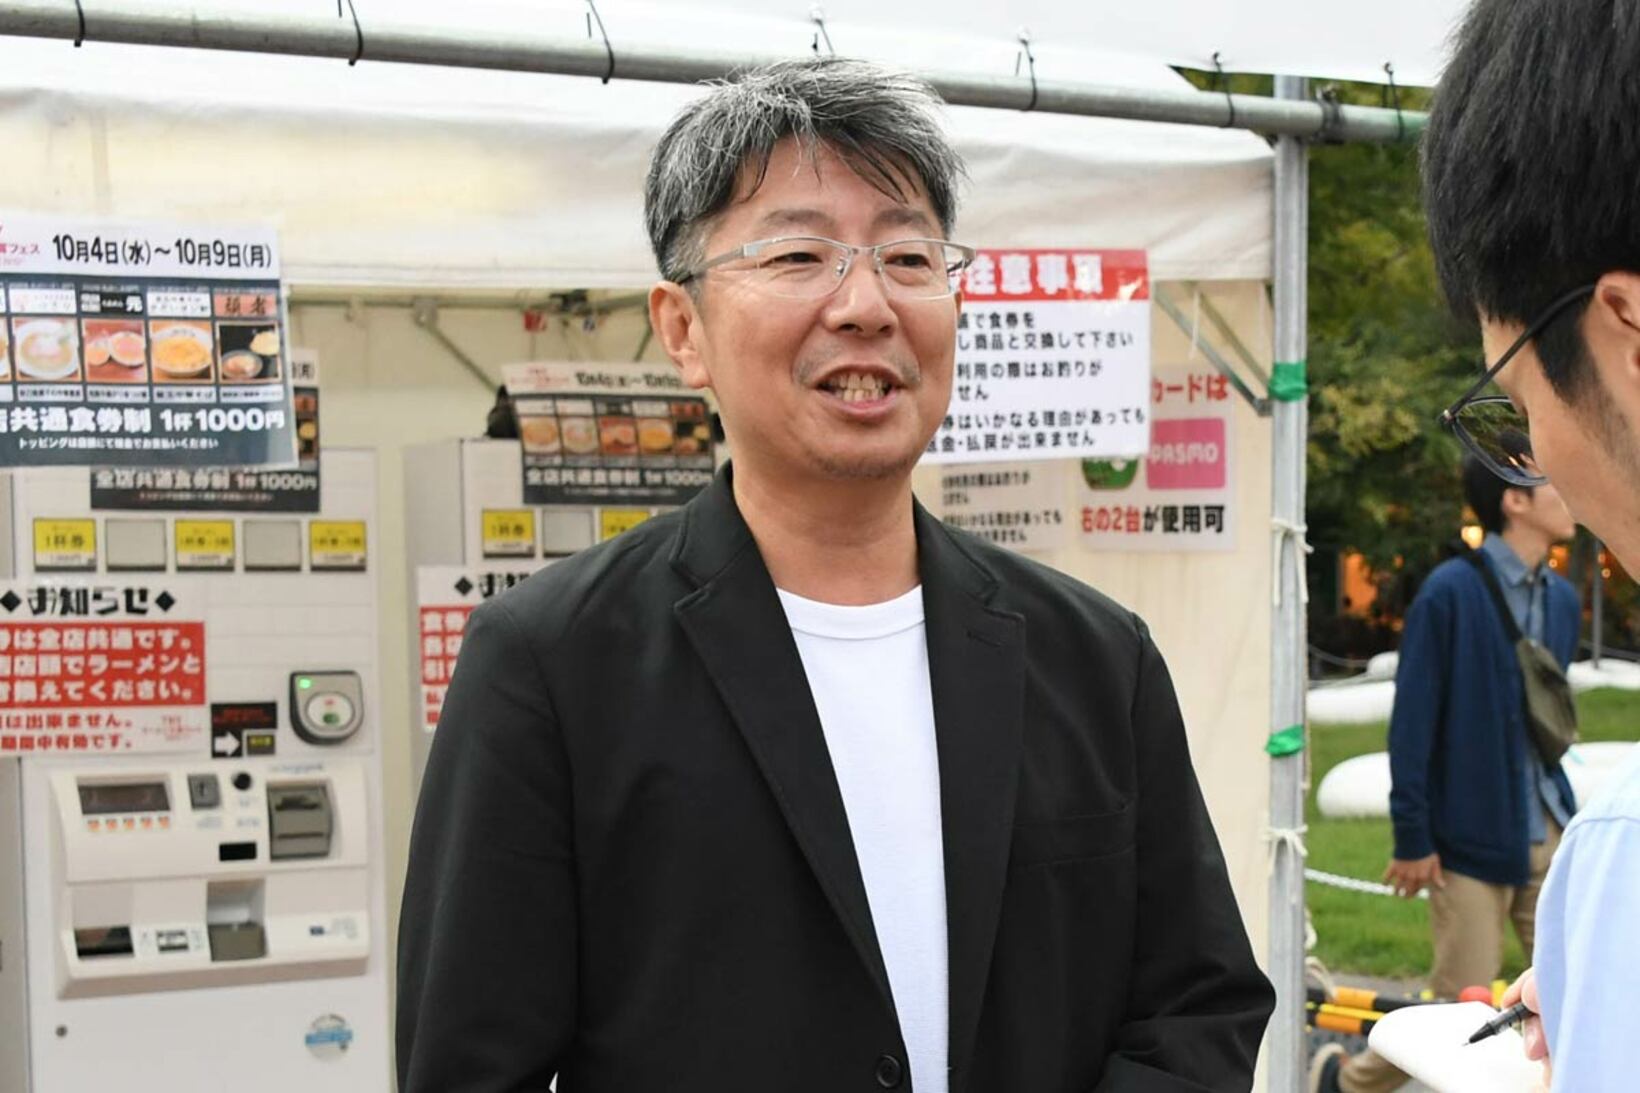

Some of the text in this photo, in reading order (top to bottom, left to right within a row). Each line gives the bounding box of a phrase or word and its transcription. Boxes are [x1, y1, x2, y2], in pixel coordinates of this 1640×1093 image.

[948, 253, 1102, 295] 注意事項
[159, 408, 285, 433] 1杯1000円
[27, 586, 149, 616] お知らせ
[0, 713, 133, 730] は出来ません。
